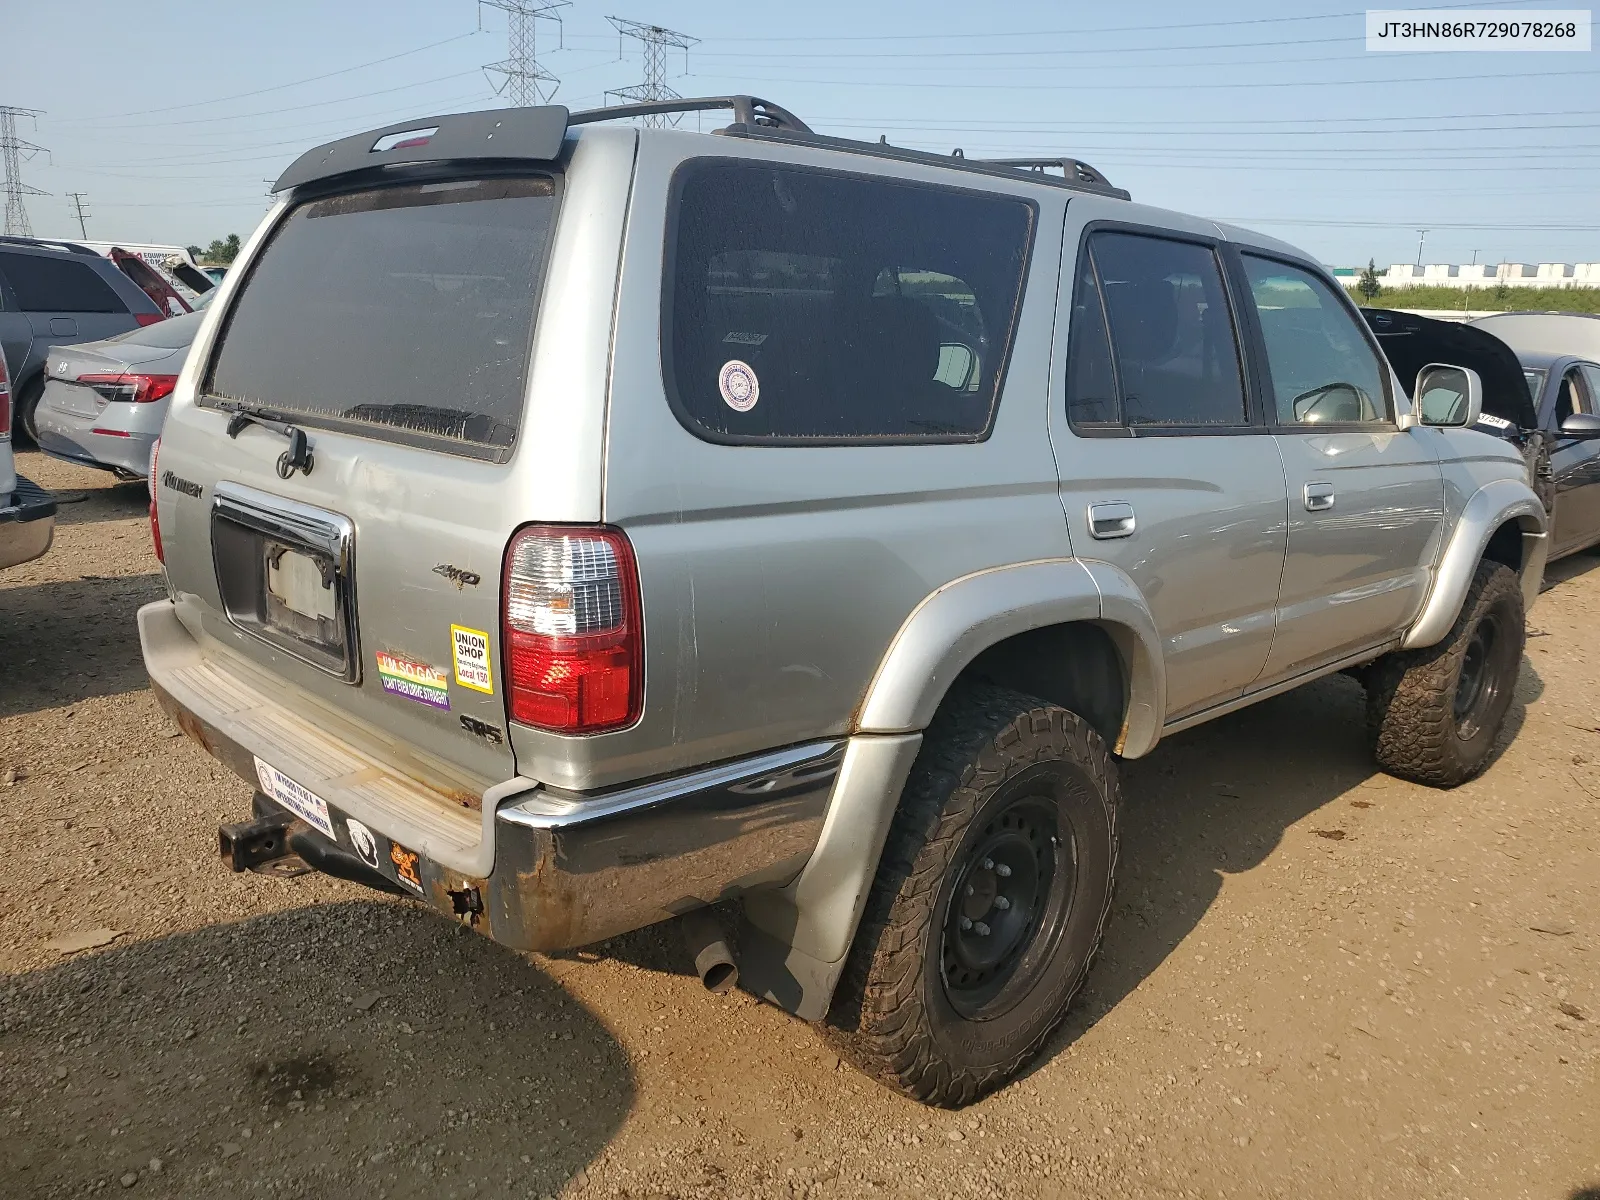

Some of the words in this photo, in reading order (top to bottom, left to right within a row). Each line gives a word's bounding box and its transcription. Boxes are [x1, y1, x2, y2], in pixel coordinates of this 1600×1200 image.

[431, 563, 481, 585] 4WD
[455, 632, 485, 649] UNION
[458, 645, 483, 660] SHOP
[399, 660, 414, 676] SO
[416, 666, 442, 682] GAY
[458, 666, 475, 680] Local
[477, 671, 488, 684] 150
[397, 679, 409, 695] EVEN
[409, 683, 424, 698] DRIVE
[423, 687, 448, 706] STRAIGHT
[459, 714, 503, 745] SR5
